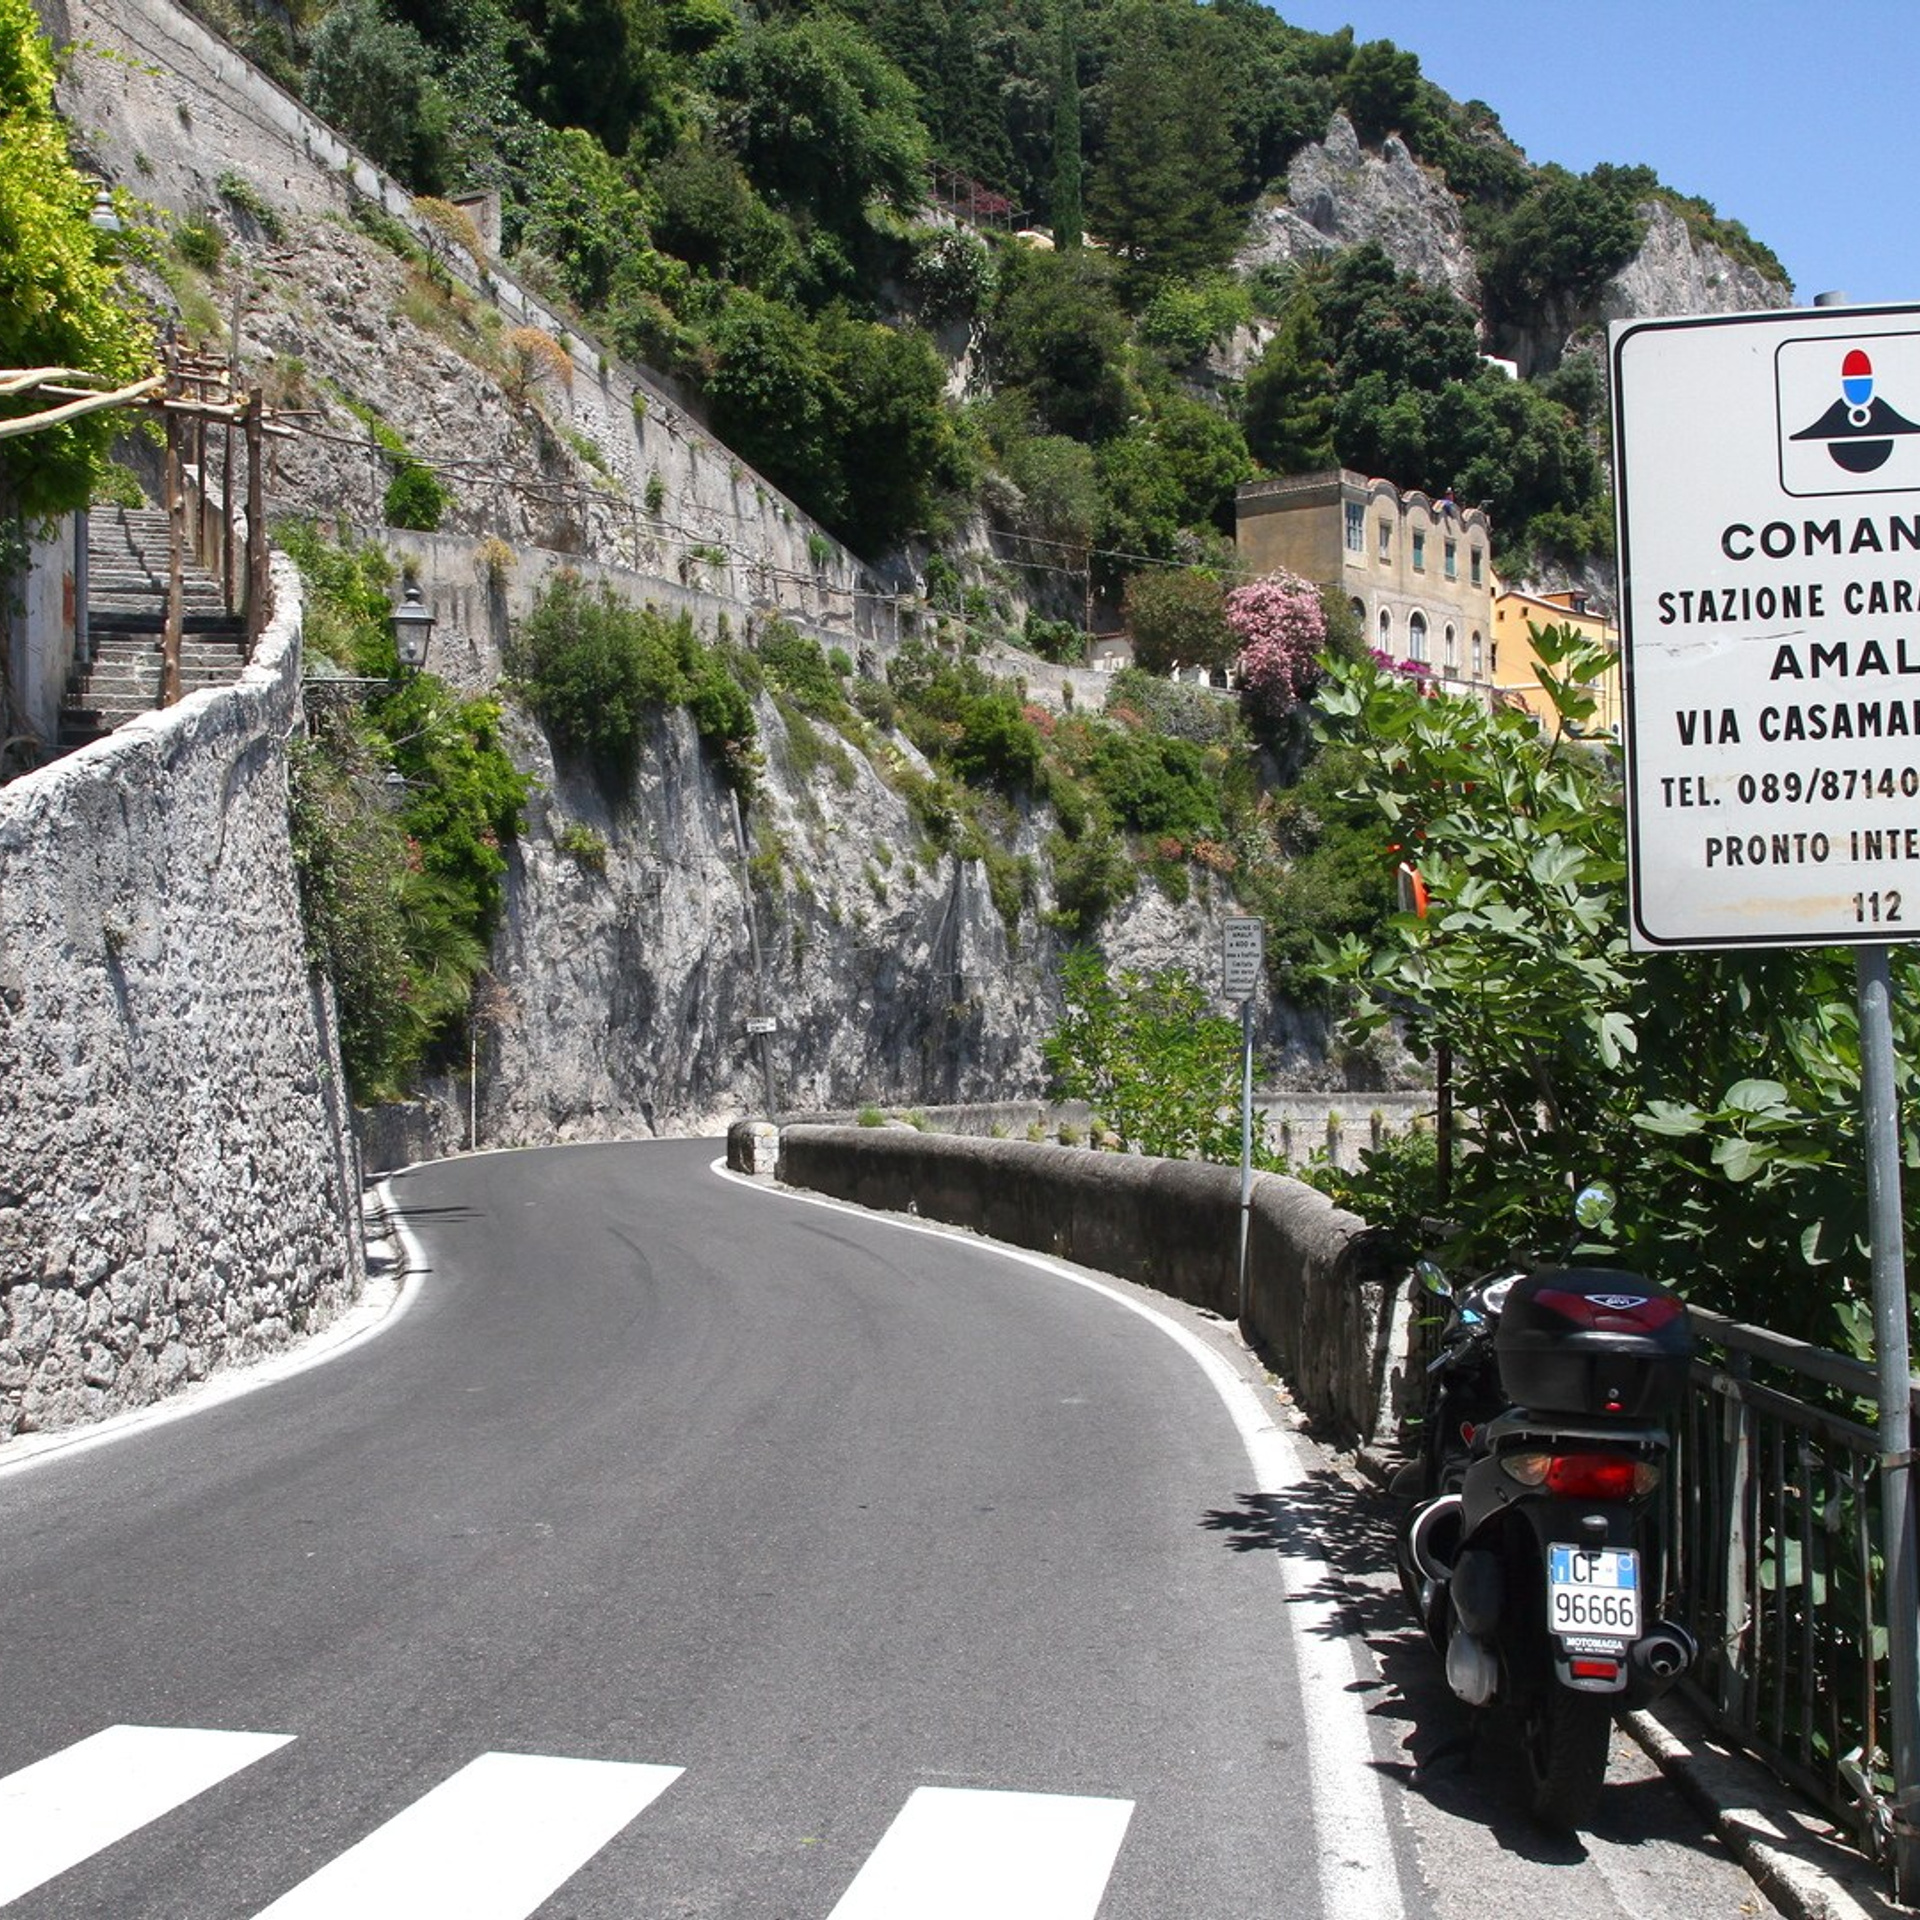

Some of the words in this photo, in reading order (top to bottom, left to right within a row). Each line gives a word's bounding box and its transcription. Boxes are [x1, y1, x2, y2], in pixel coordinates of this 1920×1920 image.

[1721, 515, 1920, 561] COMAN
[1658, 585, 1825, 625] STAZIONE
[1844, 580, 1920, 615] CAR
[1769, 639, 1920, 681] AMAL
[1676, 708, 1741, 746] VIA
[1660, 776, 1721, 808] TEL.
[1738, 767, 1919, 804] 089/87140
[1706, 833, 1830, 868] PRONTO
[1850, 829, 1920, 862] INTE
[1853, 890, 1902, 923] 112
[1573, 1552, 1602, 1583] CF
[1556, 1593, 1634, 1627] 96666
